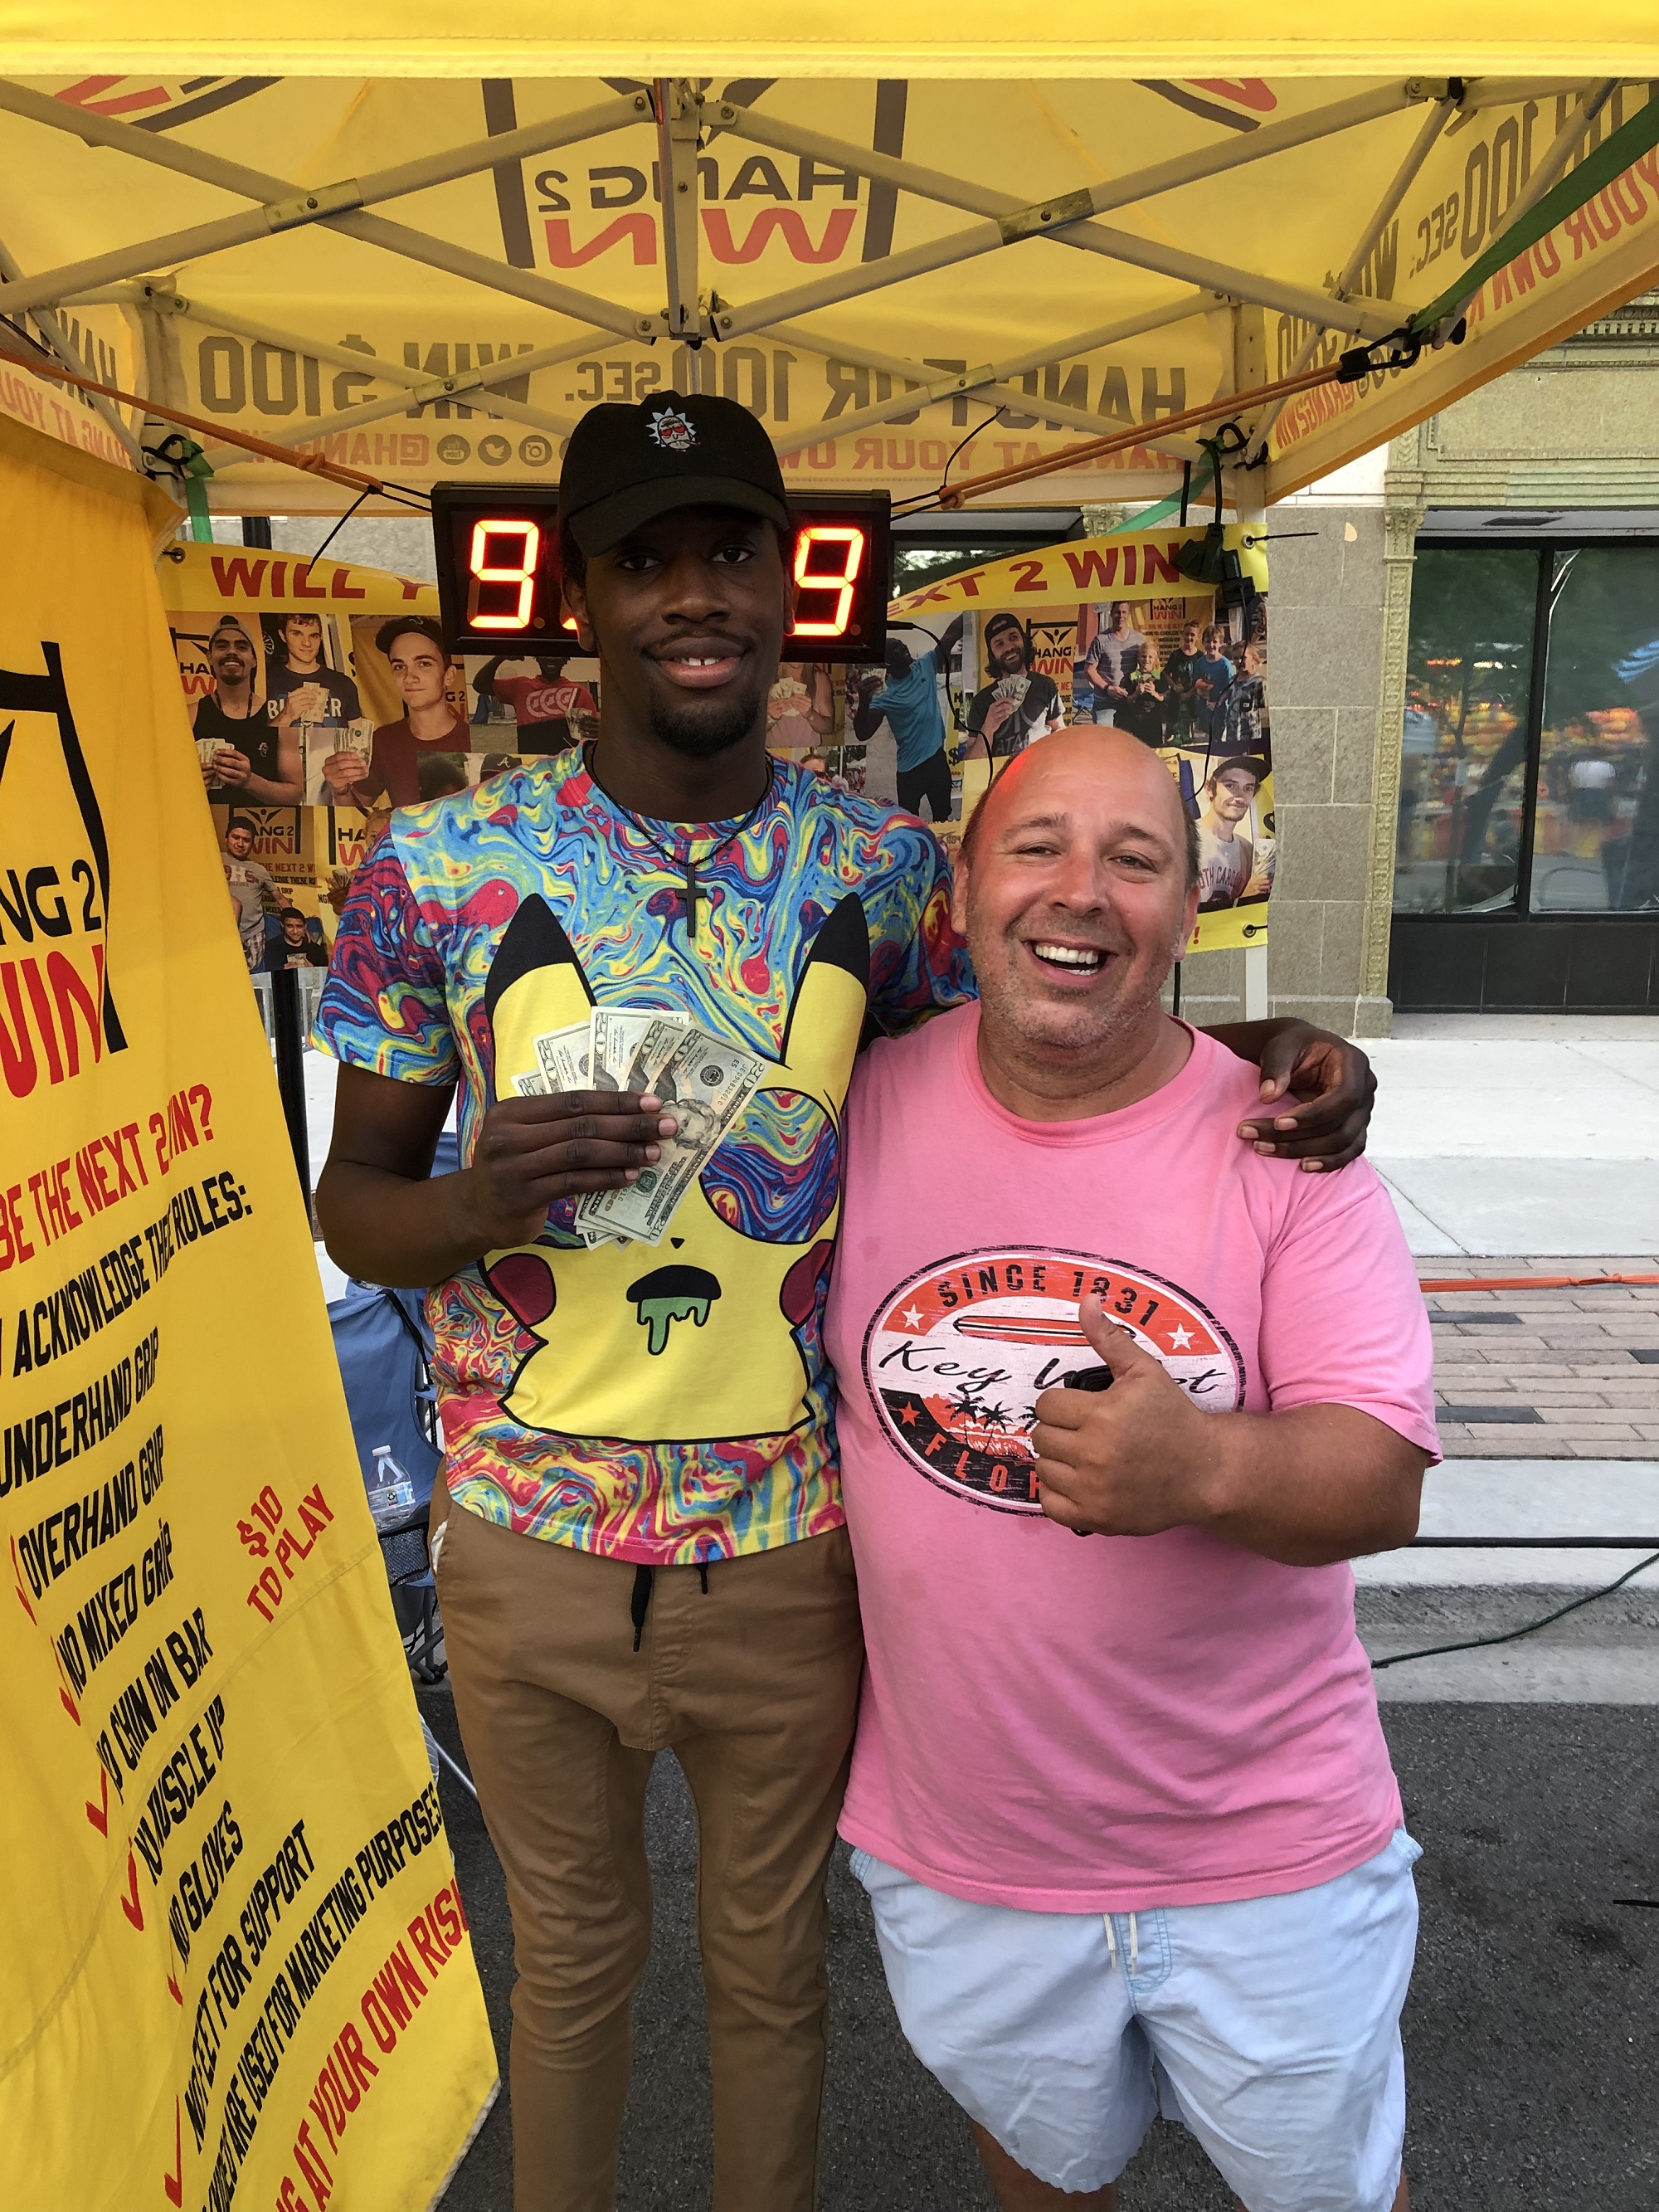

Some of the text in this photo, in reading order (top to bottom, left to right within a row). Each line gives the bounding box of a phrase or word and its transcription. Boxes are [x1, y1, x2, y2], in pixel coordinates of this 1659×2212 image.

[210, 557, 366, 598] WILL
[1009, 561, 1048, 592] 2
[1063, 543, 1181, 589] WIN
[72, 859, 102, 932] 2
[27, 1157, 83, 1246] THE
[75, 1122, 149, 1217] NEXT
[148, 1112, 169, 1177] 2
[12, 1235, 151, 1378] ACKNOWLEDGE
[171, 1171, 253, 1250] RULES:
[937, 1264, 1047, 1307] SINCE
[134, 1326, 158, 1404] GRIP
[878, 1341, 1013, 1393] Key
[18, 1424, 164, 1600] OVERHAND GRIP
[236, 1485, 283, 1557] $10
[247, 1483, 335, 1624] TO PLAY
[57, 1523, 174, 1701] NO MIXED GRIP
[109, 1677, 158, 1771] CHIN
[144, 1647, 181, 1719] ON
[165, 1606, 214, 1689] BAR
[204, 1693, 226, 1761] UP
[178, 1800, 244, 1932] GLOVES
[207, 1933, 252, 2030] FOR
[240, 1818, 315, 1967] SUPPORT
[224, 1781, 442, 2166] ARE USED FOR MARKETING PURPOSES
[361, 1940, 429, 2054] OWN
[309, 2022, 380, 2156] YOUR
[293, 2118, 334, 2212] AT
